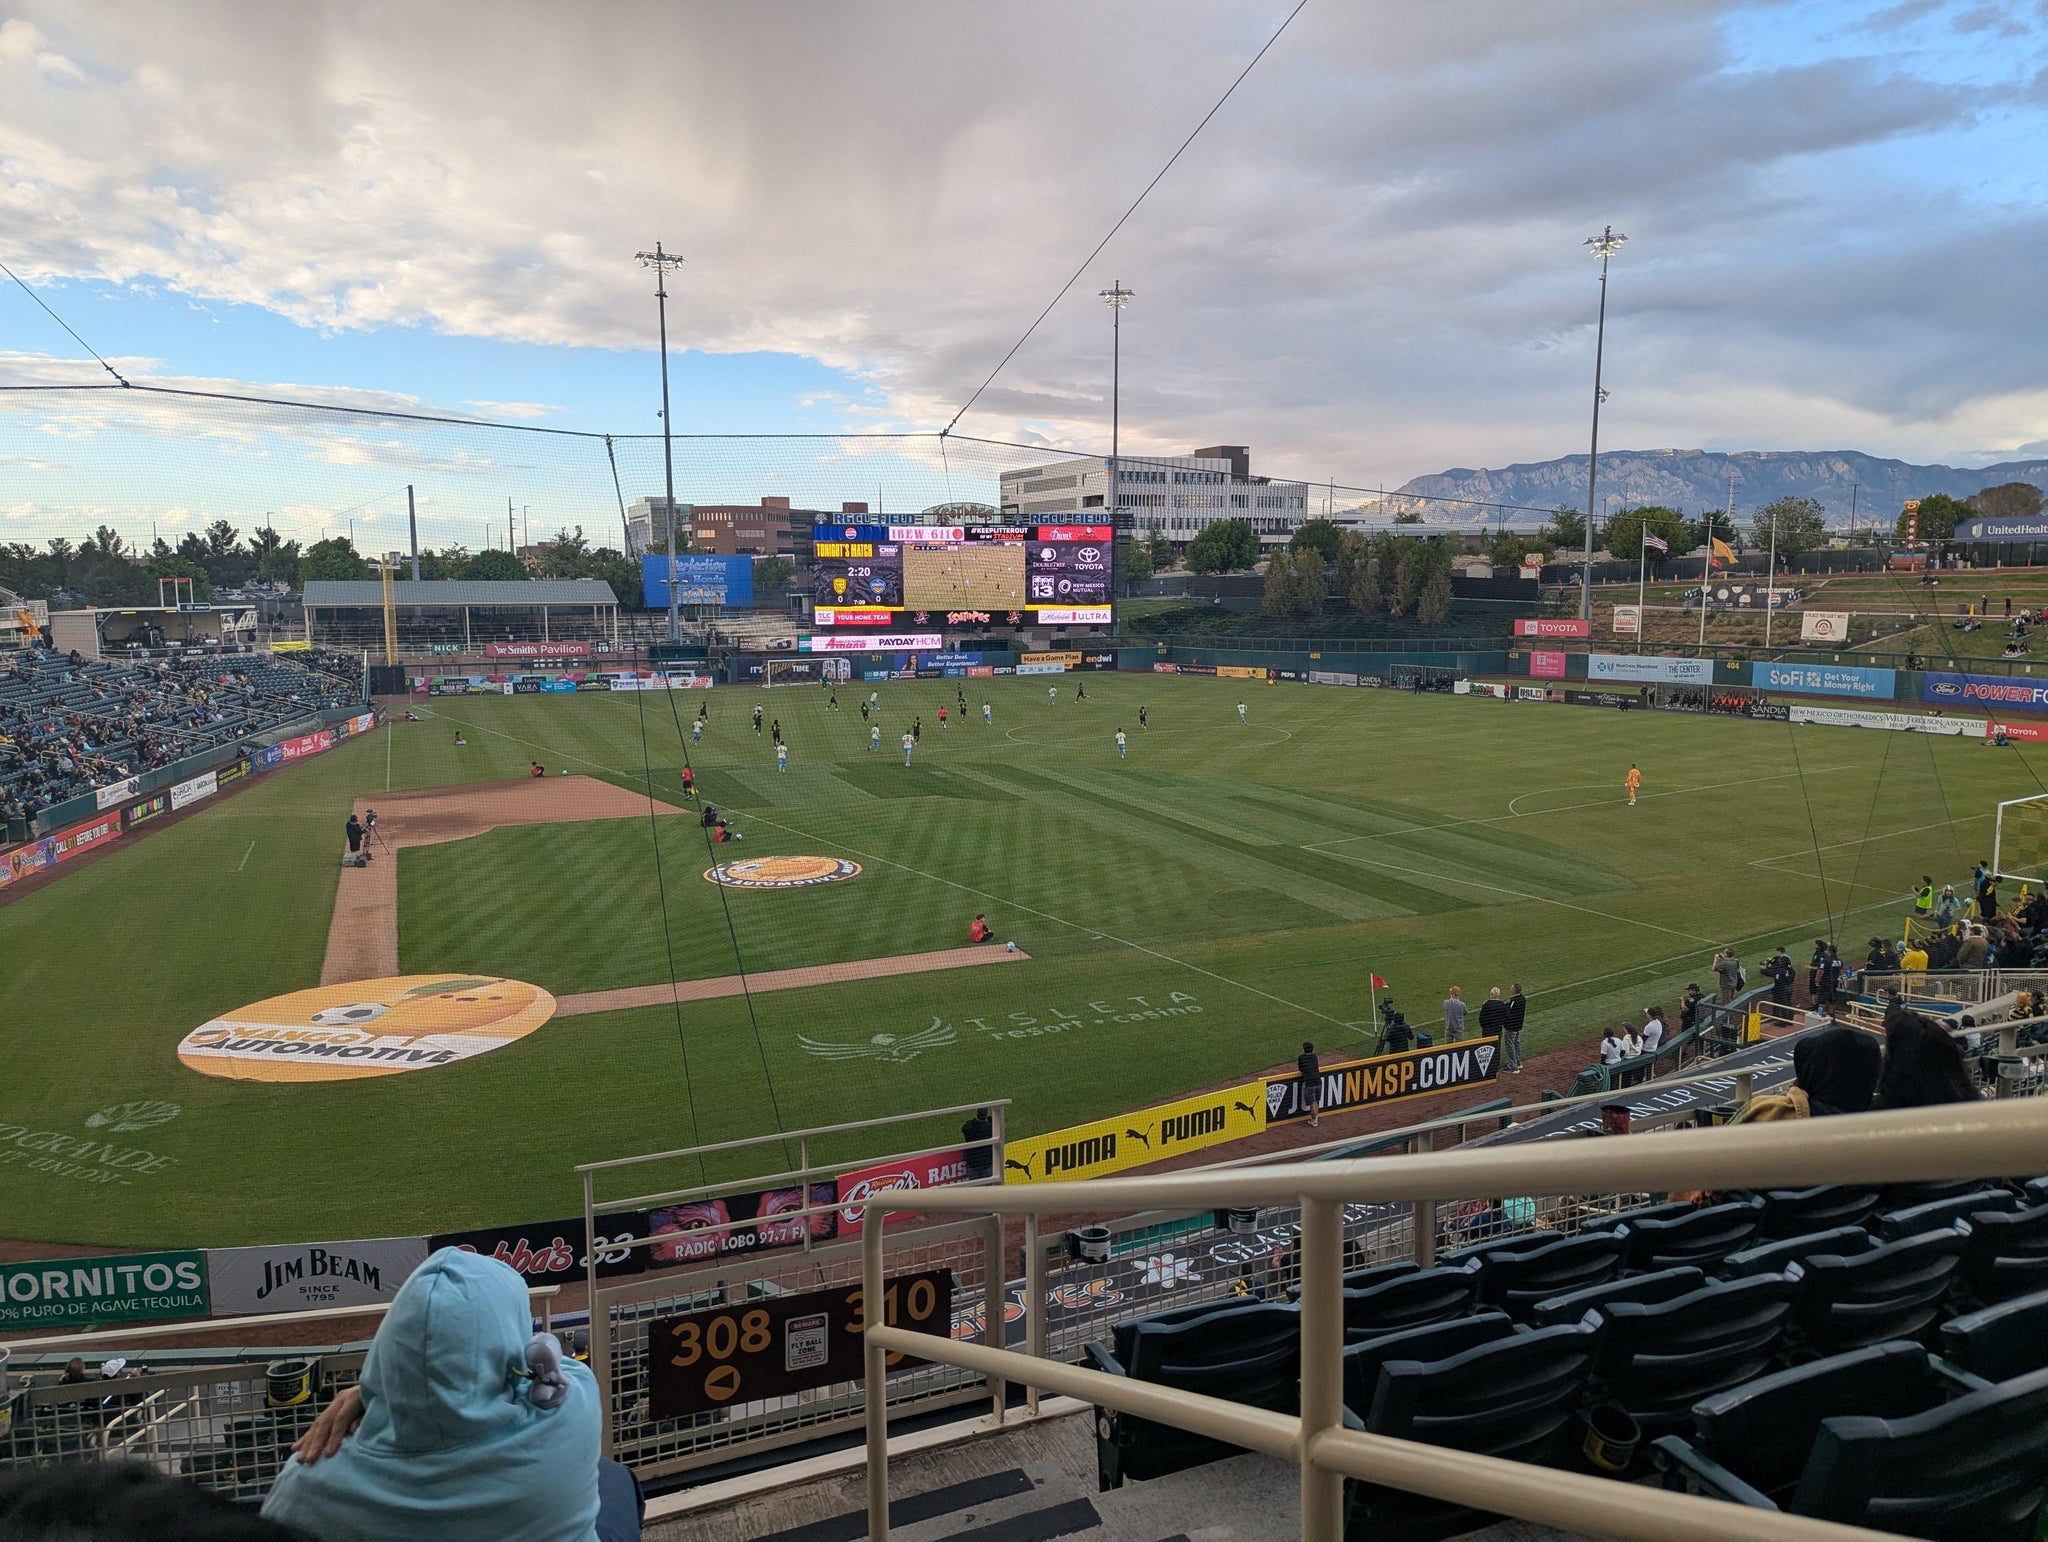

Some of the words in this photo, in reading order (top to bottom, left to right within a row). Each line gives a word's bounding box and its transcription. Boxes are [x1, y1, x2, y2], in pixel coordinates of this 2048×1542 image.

[834, 513, 870, 525] RGCU
[877, 513, 915, 525] FIELD
[1029, 513, 1067, 524] RGCU
[1072, 513, 1110, 524] FIELD
[891, 528, 924, 539] IBEW
[816, 543, 850, 558] TONIGHT'S
[851, 543, 873, 558] MATCH
[675, 557, 727, 573] erfection
[1074, 563, 1104, 571] TOYOTA
[847, 567, 871, 577] 2:20
[1033, 586, 1053, 598] 13
[837, 595, 844, 603] 0
[875, 595, 882, 603] 0
[1078, 612, 1108, 620] ULTRA
[1540, 624, 1578, 632] TOYOTA
[825, 637, 867, 649] Amana
[507, 644, 538, 655] Smith's
[540, 643, 583, 654] Pavilion
[927, 660, 946, 668] Better
[1086, 654, 1113, 663] endwi
[792, 665, 811, 673] TIME
[1668, 665, 1678, 673] THE
[1679, 665, 1700, 674] CENTER
[1726, 661, 1740, 670] 404
[1359, 676, 1382, 684] SANDIA
[1770, 669, 1804, 686] SoFi
[1824, 673, 1840, 681] Get
[1841, 673, 1860, 682] Your
[1824, 680, 1851, 690] Money
[1853, 683, 1876, 692] Right
[1935, 683, 1956, 693] Ford
[1750, 705, 1787, 714] SANDIA
[1806, 709, 1832, 717] MEXICO
[1833, 712, 1884, 721] ORTHOPAEDICS
[1886, 714, 1904, 722] WILL
[1907, 716, 1942, 725] FERGUSON
[1945, 720, 1987, 729] ASSOCIATES
[2008, 728, 2038, 736] TOYOTA
[56, 842, 68, 854] CALL
[76, 831, 93, 846] BEFORE
[92, 827, 100, 838] YOU
[731, 874, 839, 888] AUTOMOTIVE
[964, 991, 1198, 1033] ISLETA
[991, 1020, 1084, 1041] resort
[1113, 1005, 1204, 1024] casino
[196, 1037, 461, 1064] AUTOMOTIVE
[1161, 1105, 1226, 1146] PUMA
[1045, 1133, 1116, 1176] PUMA
[870, 1176, 898, 1189] Raising
[722, 1234, 756, 1250] LOBO
[760, 1228, 788, 1244] 97.7
[256, 1257, 305, 1299] JIM
[309, 1248, 381, 1292] BEAM
[299, 1284, 341, 1294] SINCE
[306, 1293, 335, 1302] 1795
[23, 1304, 64, 1318] PURO
[68, 1303, 87, 1315] DE
[91, 1298, 140, 1313] AGAVE
[141, 1294, 203, 1308] TEQUILA
[791, 1318, 822, 1329] BEWARE
[671, 1309, 772, 1367] 308
[791, 1341, 804, 1349] FLY
[805, 1338, 823, 1347] BALL
[798, 1345, 817, 1355] ZONE
